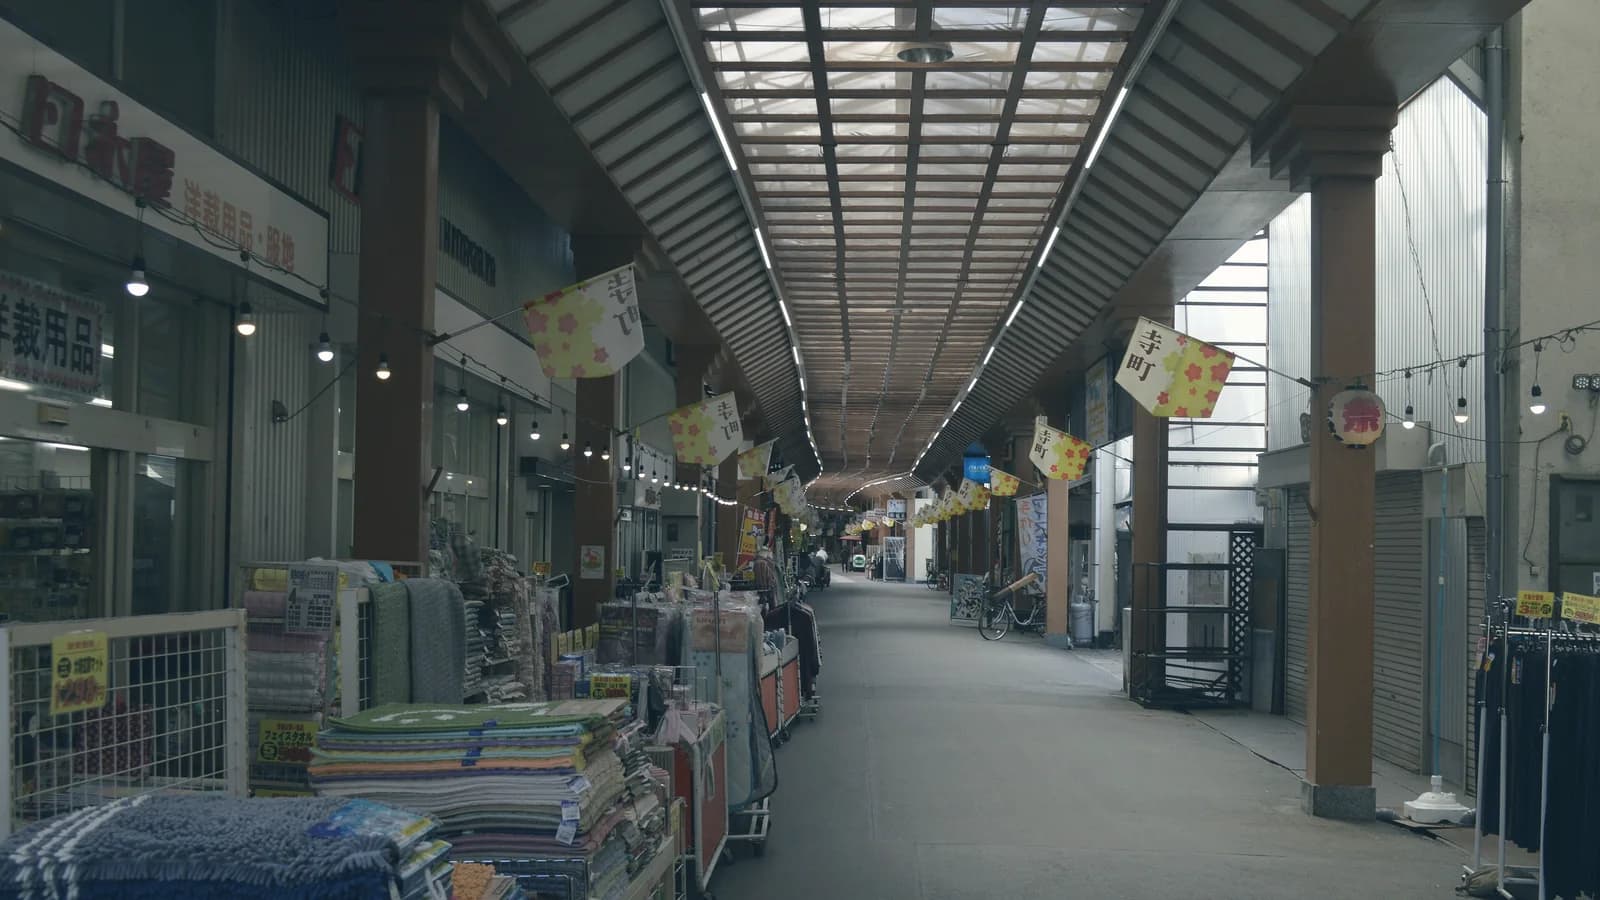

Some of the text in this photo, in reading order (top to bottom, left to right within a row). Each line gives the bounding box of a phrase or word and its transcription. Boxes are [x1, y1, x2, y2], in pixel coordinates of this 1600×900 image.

[1127, 330, 1161, 381] 寺町
[1035, 430, 1051, 459] 寺町
[265, 730, 313, 741] フェイスタオル
